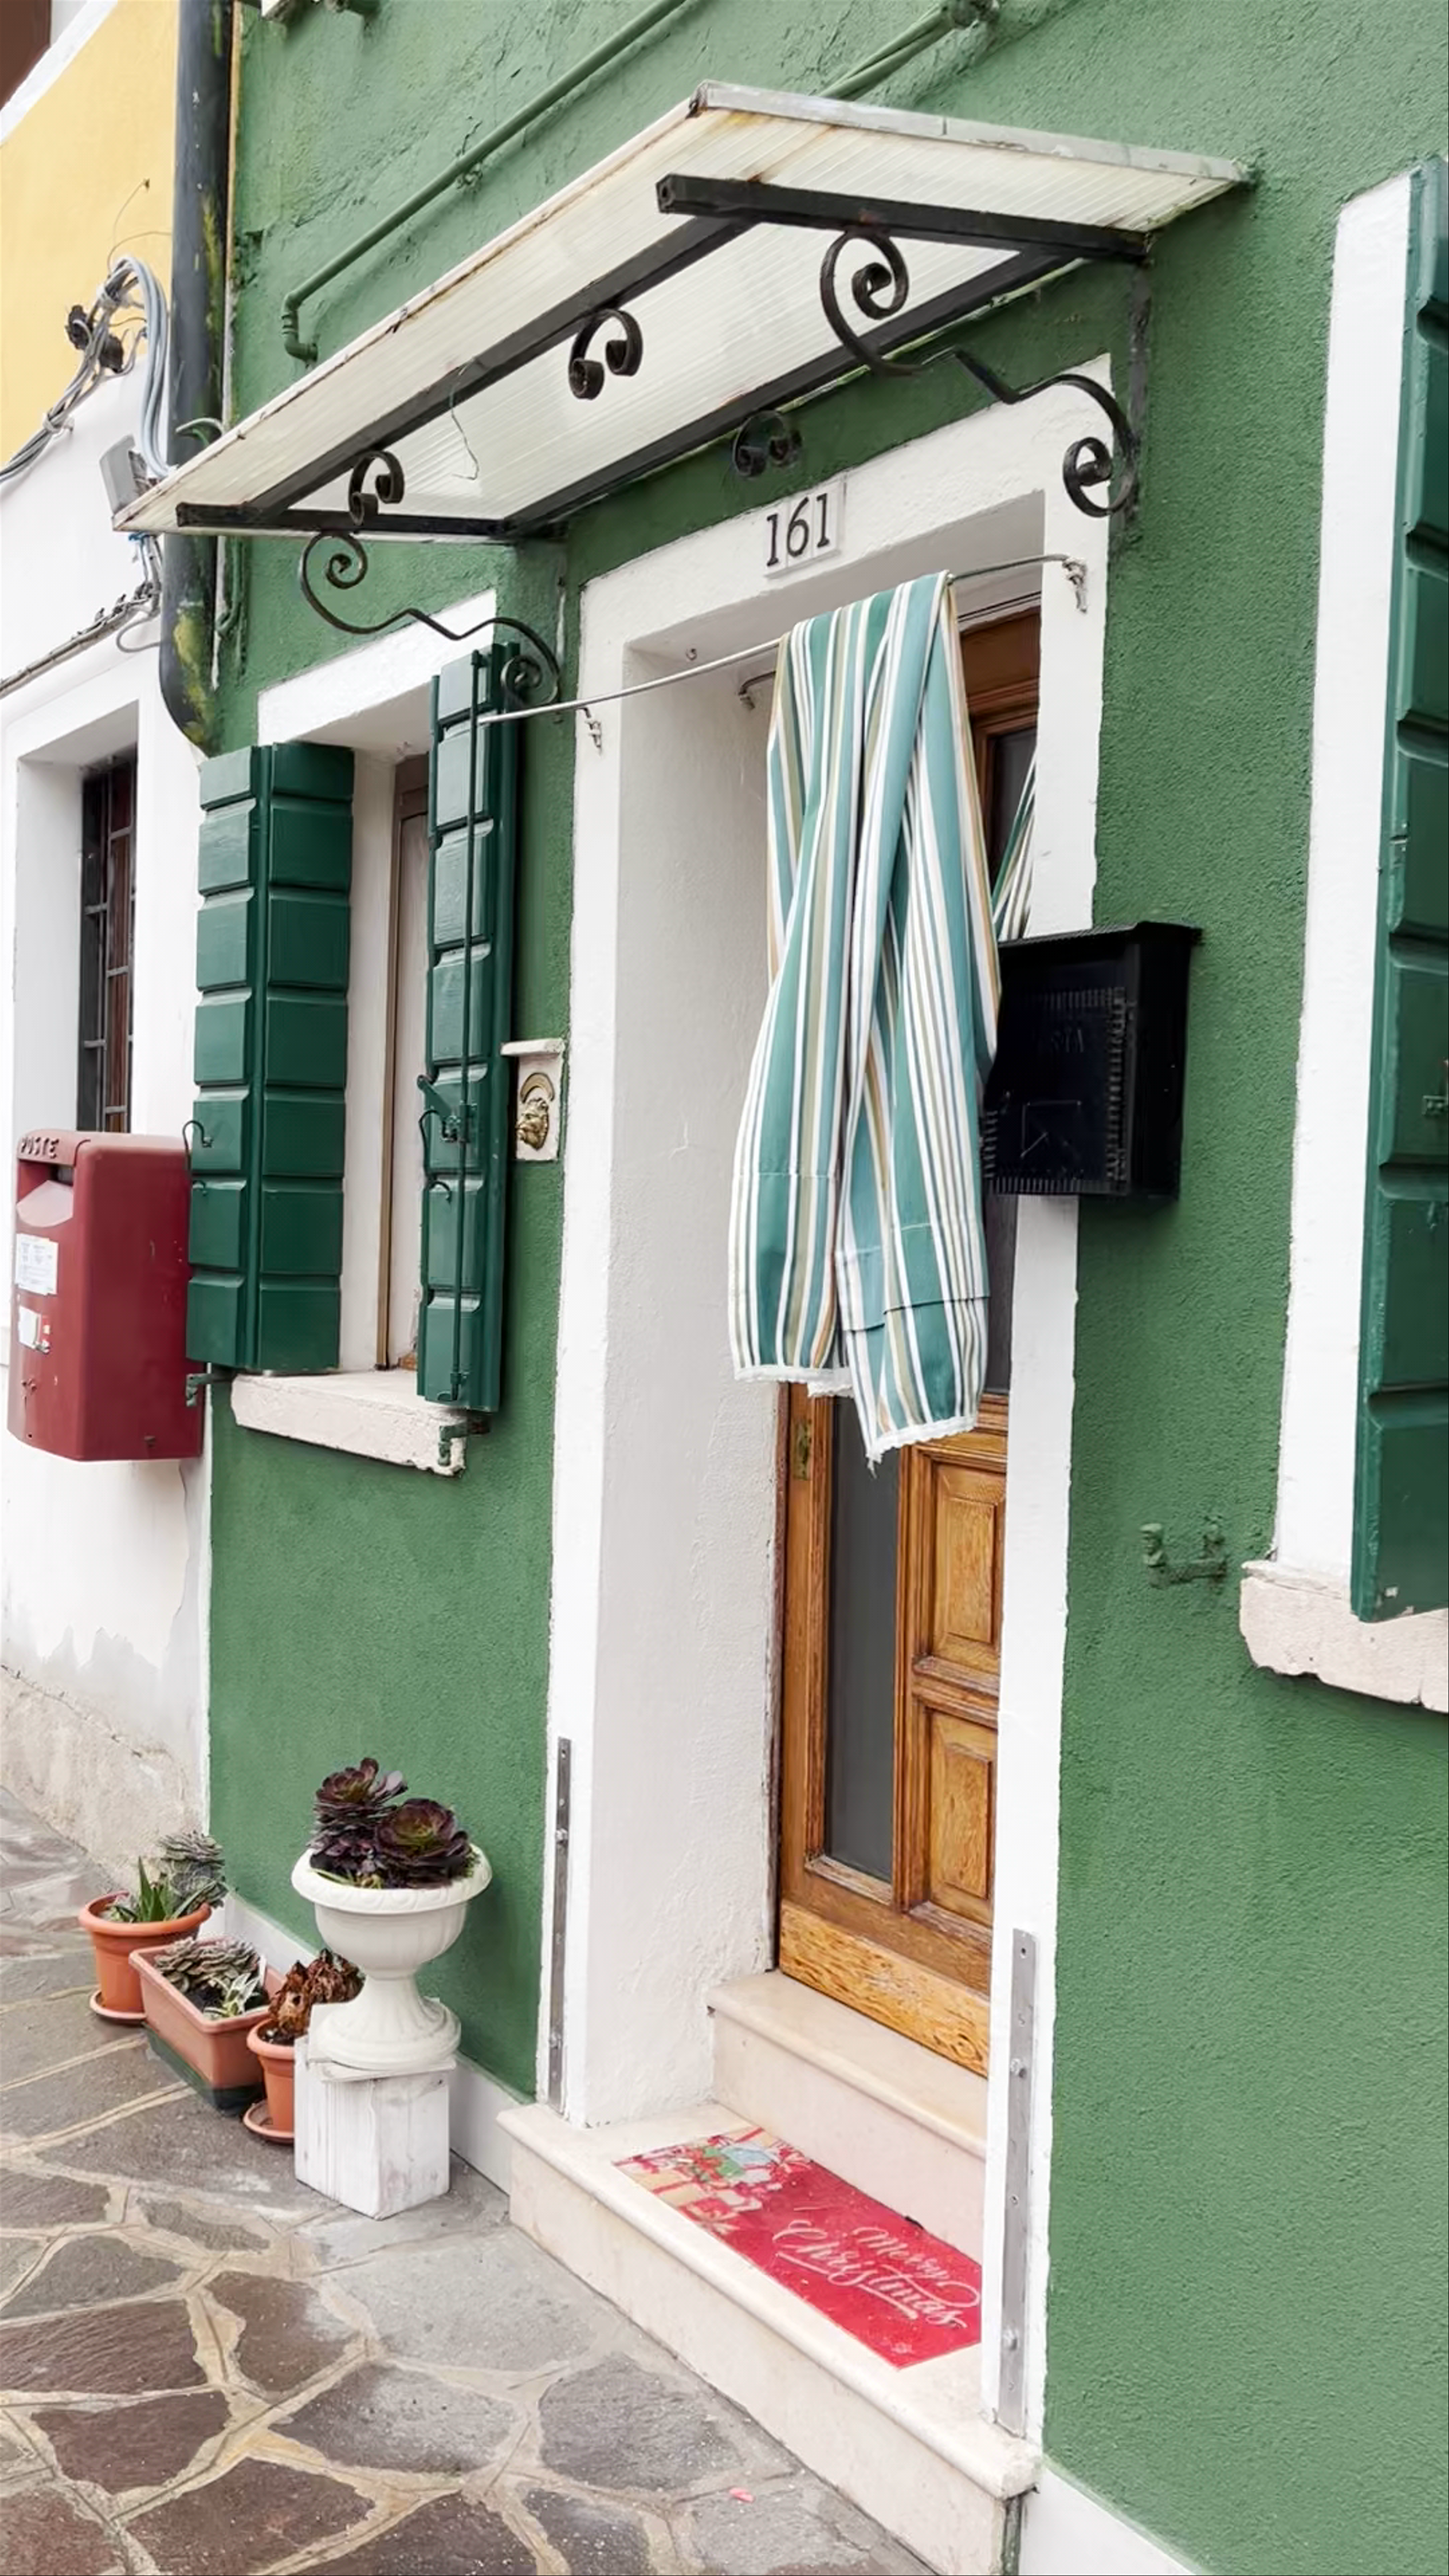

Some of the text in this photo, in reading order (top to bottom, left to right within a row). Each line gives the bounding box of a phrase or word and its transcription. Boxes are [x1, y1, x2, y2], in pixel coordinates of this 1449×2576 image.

[766, 493, 830, 567] 161
[772, 2219, 980, 2328] Christmas
[851, 2226, 952, 2285] Merry
